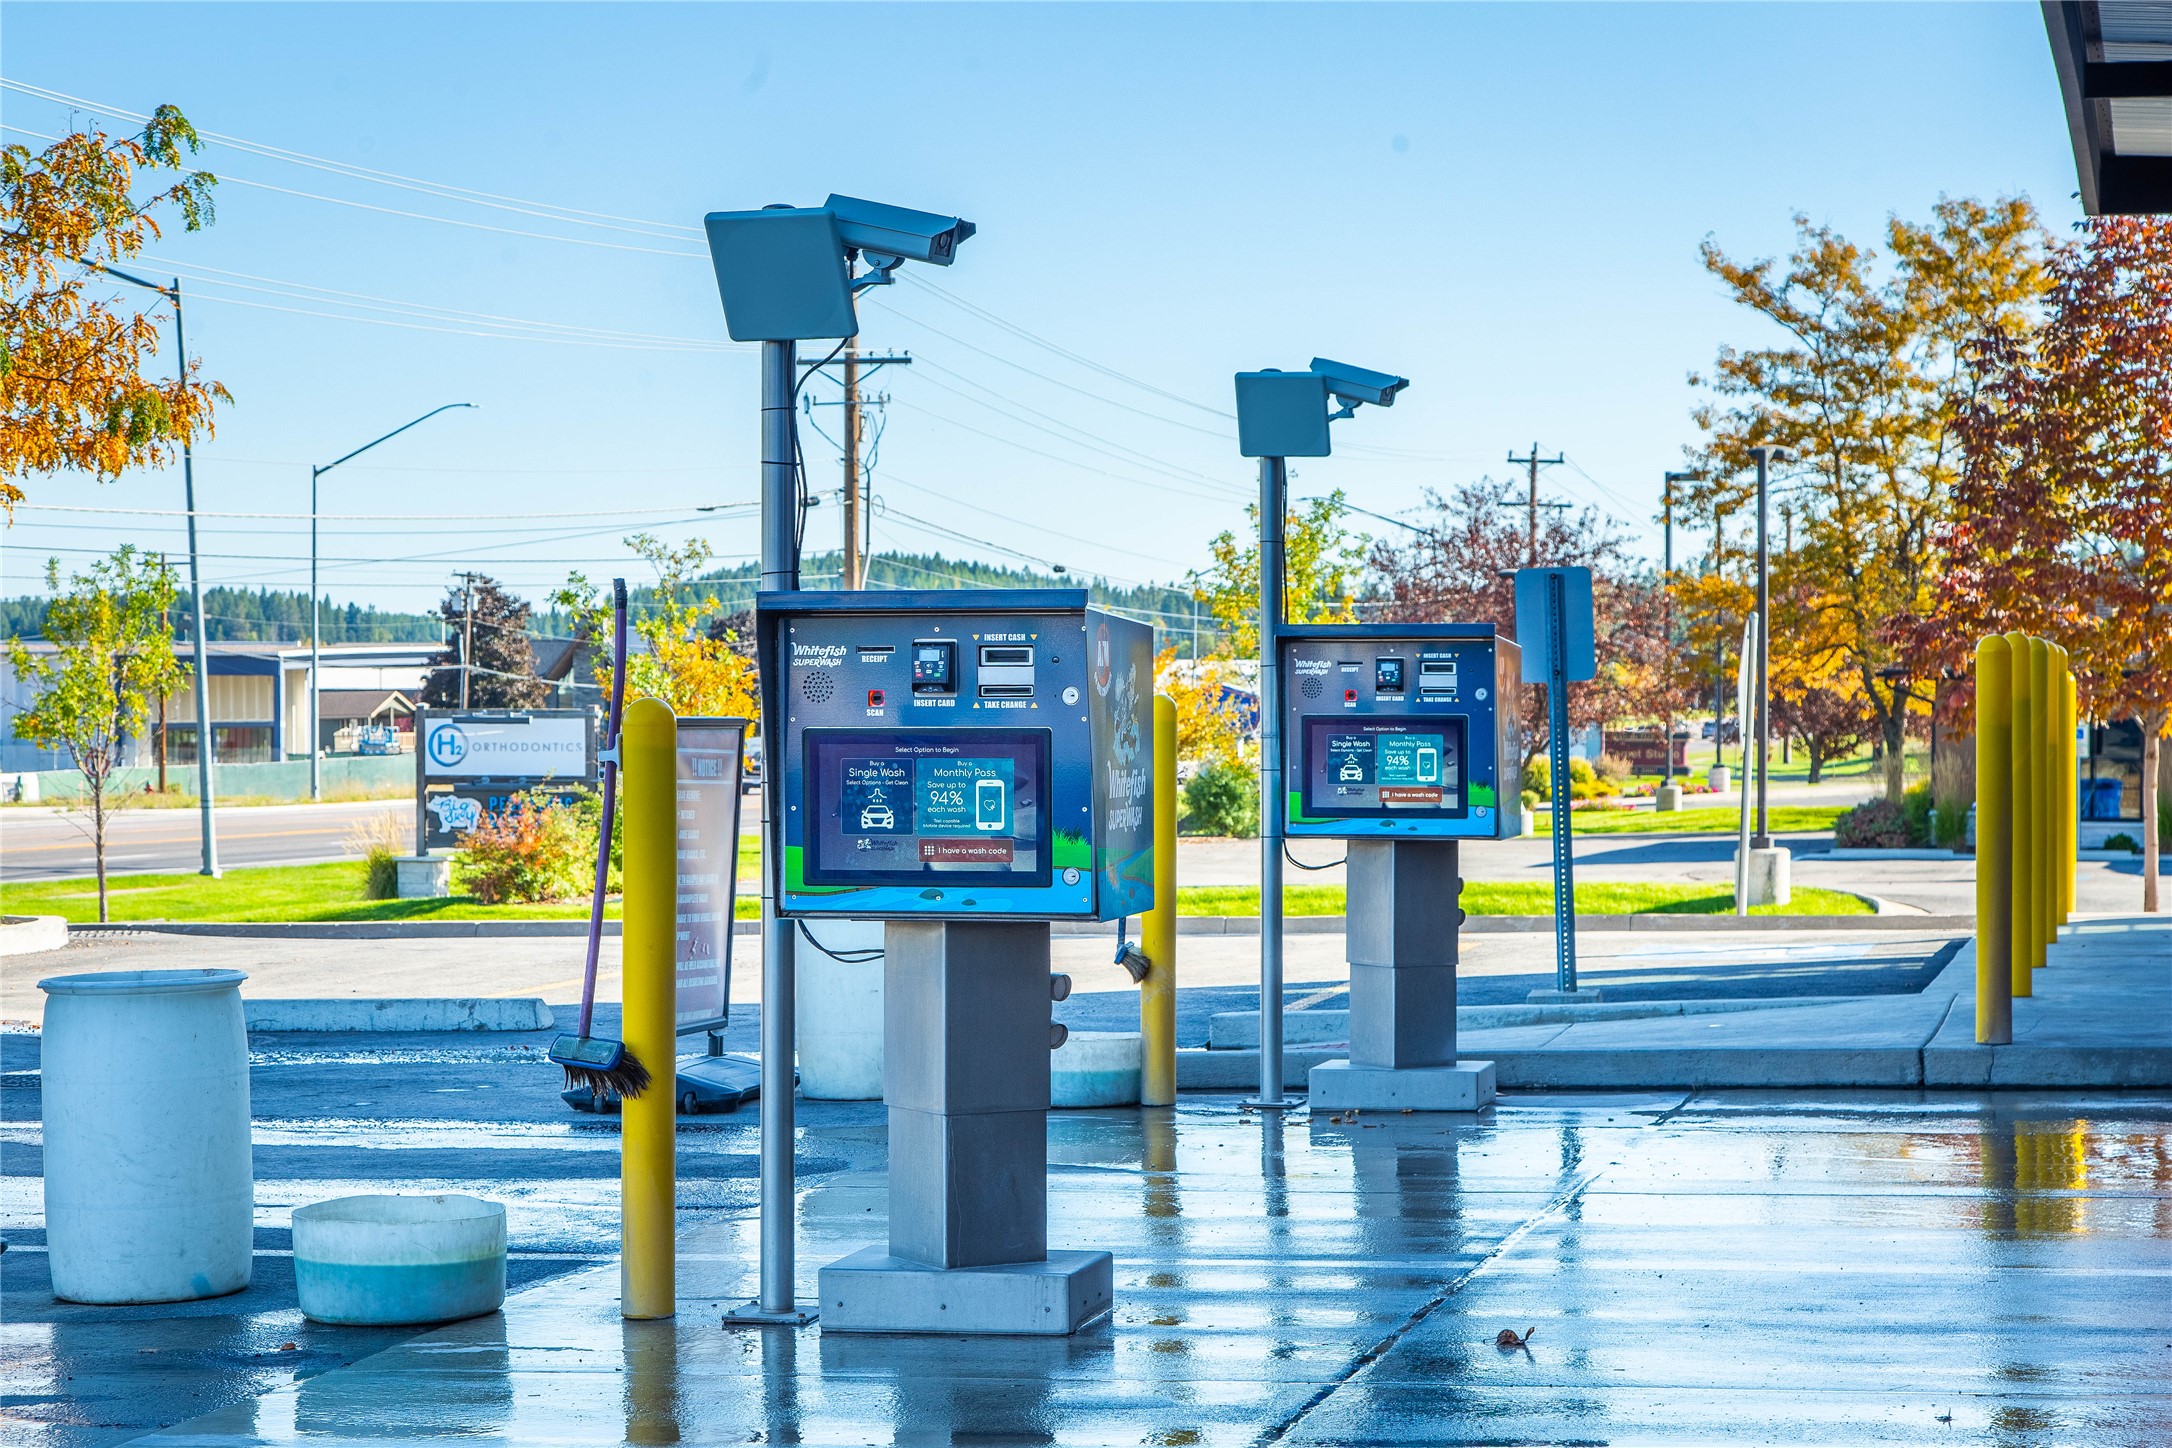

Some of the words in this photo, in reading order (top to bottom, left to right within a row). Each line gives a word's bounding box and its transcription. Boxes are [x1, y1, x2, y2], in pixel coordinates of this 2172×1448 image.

[790, 642, 847, 658] Whitefish
[861, 655, 888, 663] RECEIPT
[1294, 658, 1332, 668] Whitefish
[866, 709, 884, 717] SCAN
[472, 742, 583, 752] ORTHODONTICS
[1386, 755, 1409, 766] 94%
[698, 758, 717, 776] NOTICE
[849, 768, 878, 778] Single
[880, 768, 905, 777] Wash
[934, 768, 972, 778] Monthly
[975, 769, 996, 777] Pass
[1107, 760, 1146, 804] Whitefish
[930, 791, 963, 805] 94%
[439, 799, 469, 812] Big
[444, 807, 476, 824] Sky
